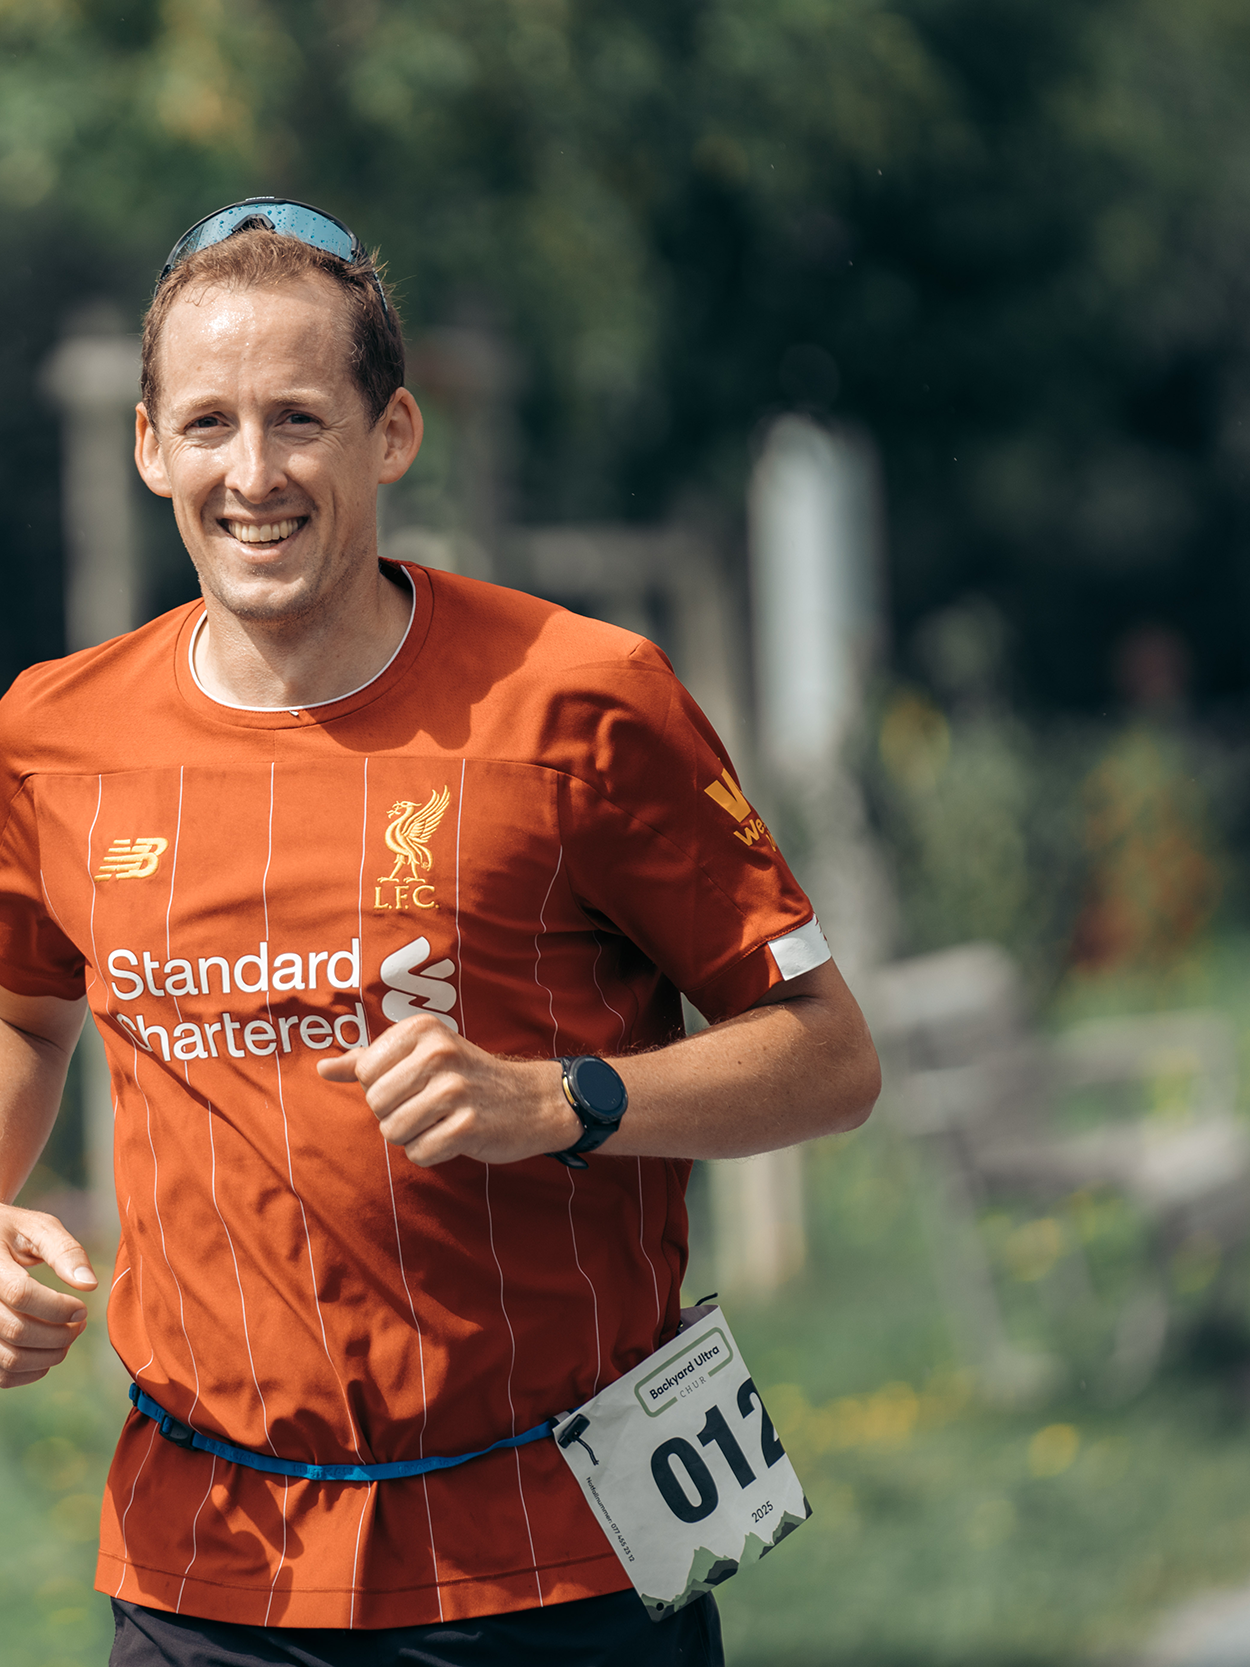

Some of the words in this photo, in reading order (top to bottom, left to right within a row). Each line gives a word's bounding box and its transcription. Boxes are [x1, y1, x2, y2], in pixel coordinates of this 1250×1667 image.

[373, 884, 440, 910] L.F.C.
[107, 937, 361, 1002] Standard
[649, 1361, 695, 1400] Backyard
[693, 1345, 720, 1367] Ultra
[679, 1375, 707, 1398] CHUR
[650, 1377, 786, 1524] 012
[585, 1476, 613, 1524] Notfallnummer:
[610, 1522, 621, 1534] 077
[617, 1534, 628, 1547] 455
[623, 1546, 632, 1555] 23
[628, 1554, 636, 1563] 12
[751, 1500, 774, 1524] 2025
